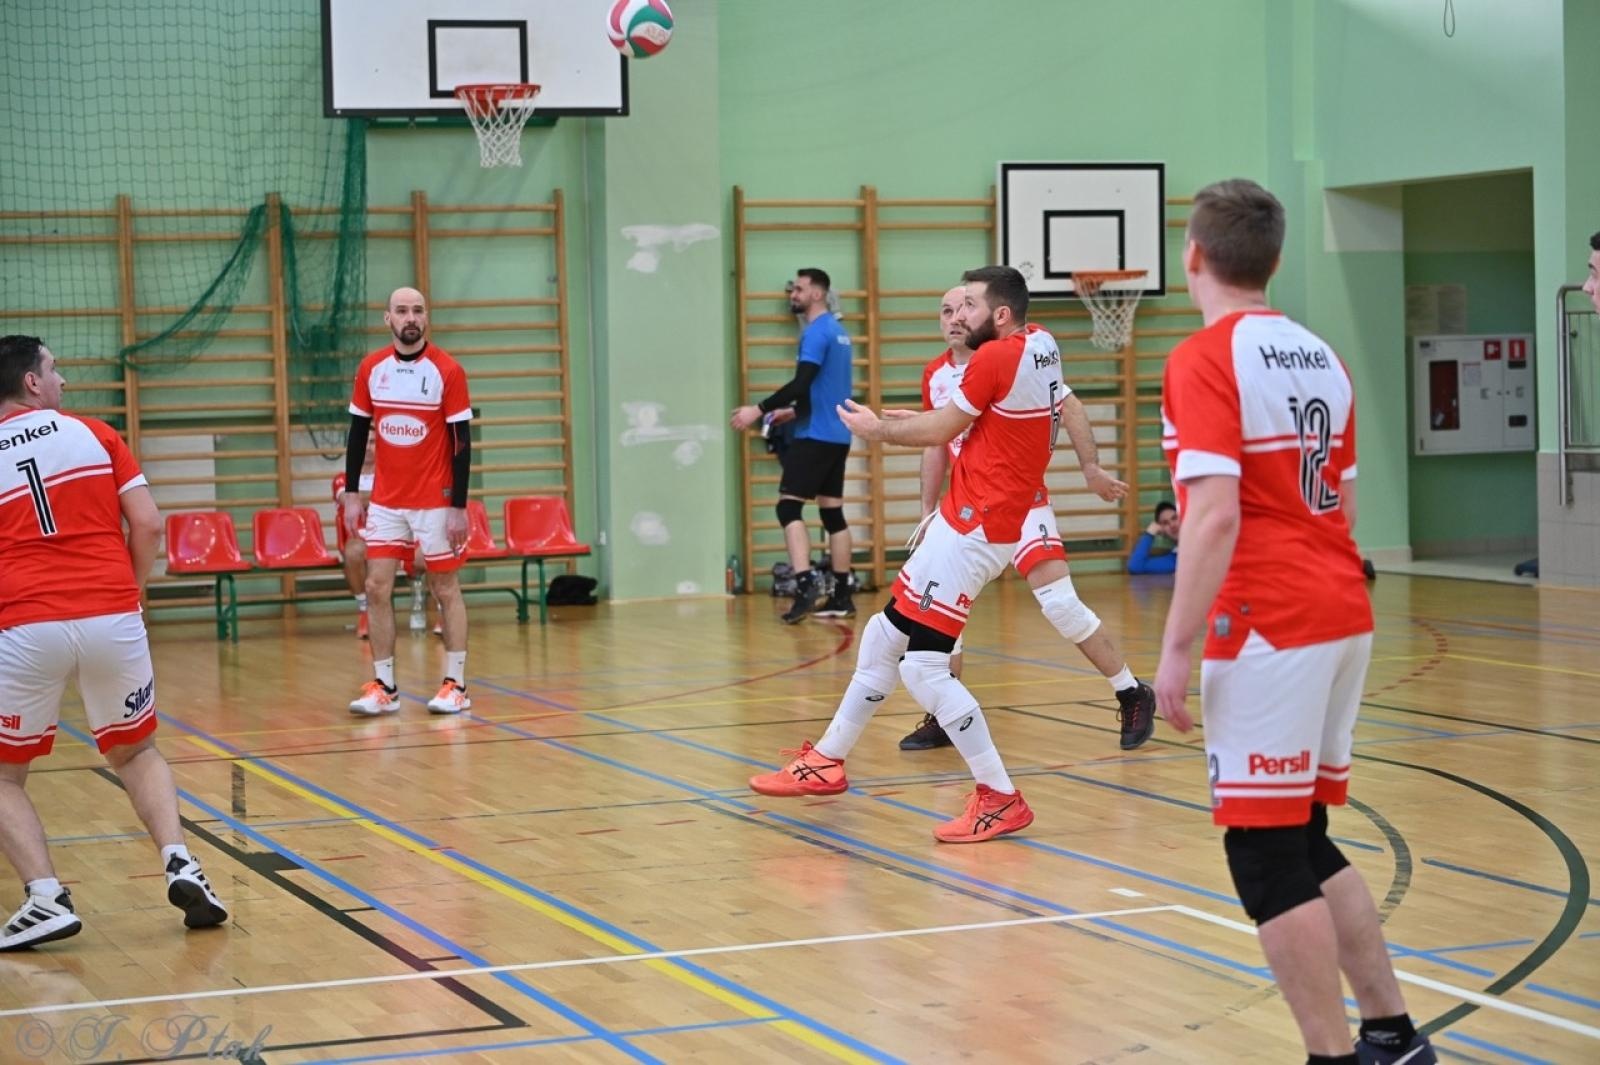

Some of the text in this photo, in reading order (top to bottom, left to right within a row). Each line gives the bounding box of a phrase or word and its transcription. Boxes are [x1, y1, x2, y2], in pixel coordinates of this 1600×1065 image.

[1259, 346, 1331, 370] Henkel
[0, 420, 58, 450] enkel
[380, 422, 425, 438] Henkel
[1287, 397, 1340, 513] 12
[16, 457, 57, 536] 1
[1249, 750, 1311, 776] Persil
